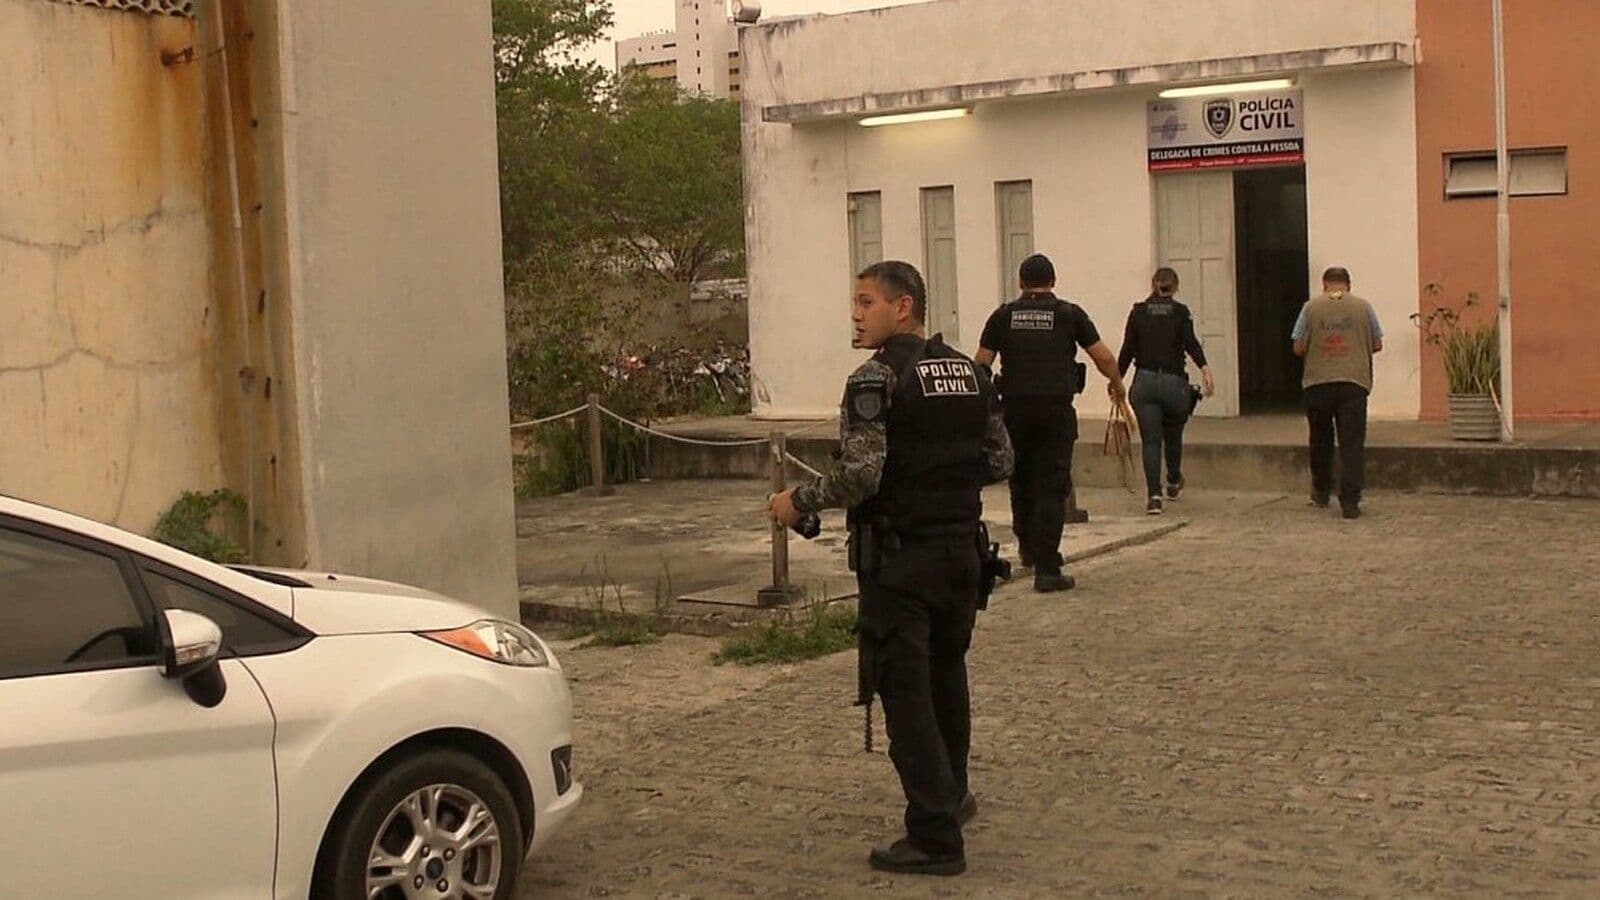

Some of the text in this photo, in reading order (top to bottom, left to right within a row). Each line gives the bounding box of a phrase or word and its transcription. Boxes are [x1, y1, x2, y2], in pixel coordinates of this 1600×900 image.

[1239, 97, 1294, 113] POLÍCIA
[1240, 112, 1295, 131] CIVIL
[1150, 142, 1300, 161] DELEGACIA DE CRIMES CONTRA A PESSOA
[934, 379, 969, 392] CIVIL
